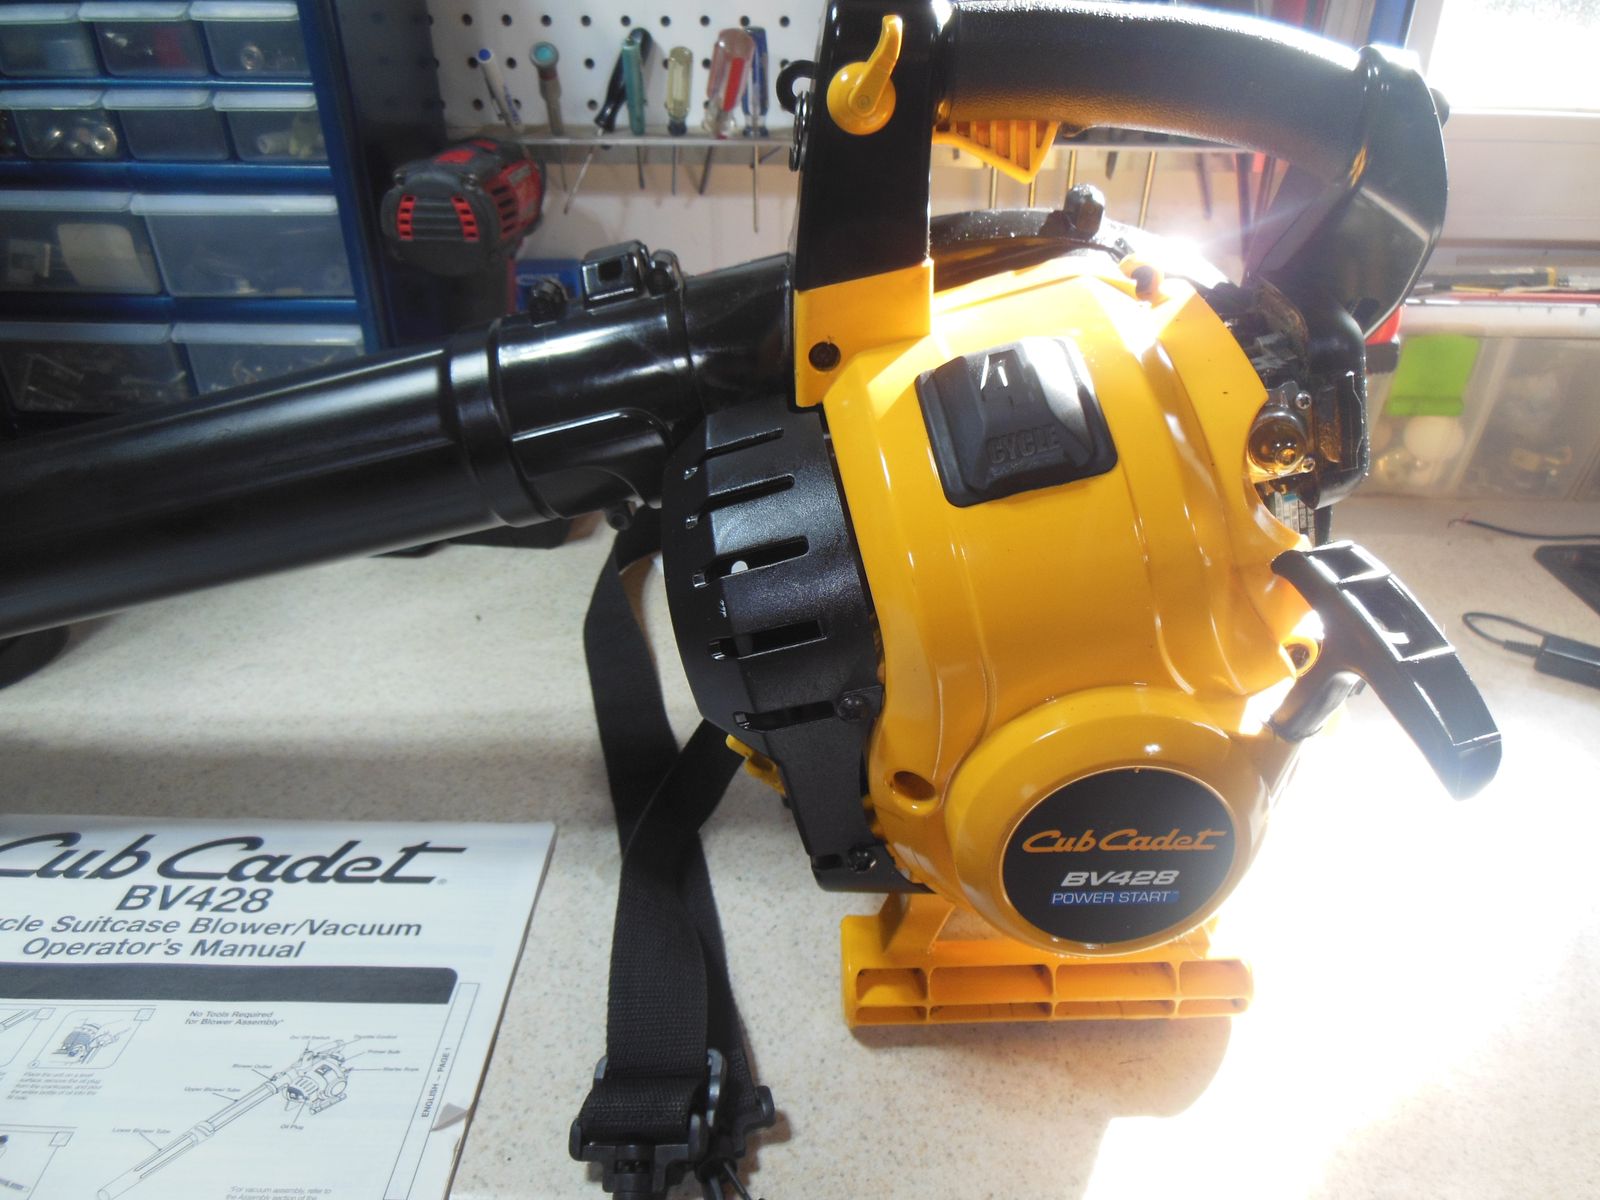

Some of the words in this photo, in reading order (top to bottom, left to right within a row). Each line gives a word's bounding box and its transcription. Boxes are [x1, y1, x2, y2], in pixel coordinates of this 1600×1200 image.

[987, 425, 1061, 464] CYCLE
[1022, 829, 1097, 853] Cub
[1099, 828, 1227, 851] Cadet
[0, 832, 157, 879] Cub
[1061, 870, 1180, 887] BV428
[115, 884, 273, 913] BV428
[1052, 891, 1114, 904] POWER
[0, 915, 44, 932] cle
[51, 915, 180, 933] Suitcase
[188, 917, 422, 936] Blower/Vacuum
[23, 937, 183, 959] Operator's
[190, 939, 306, 958] Manual
[421, 1083, 439, 1118] ENGLISH
